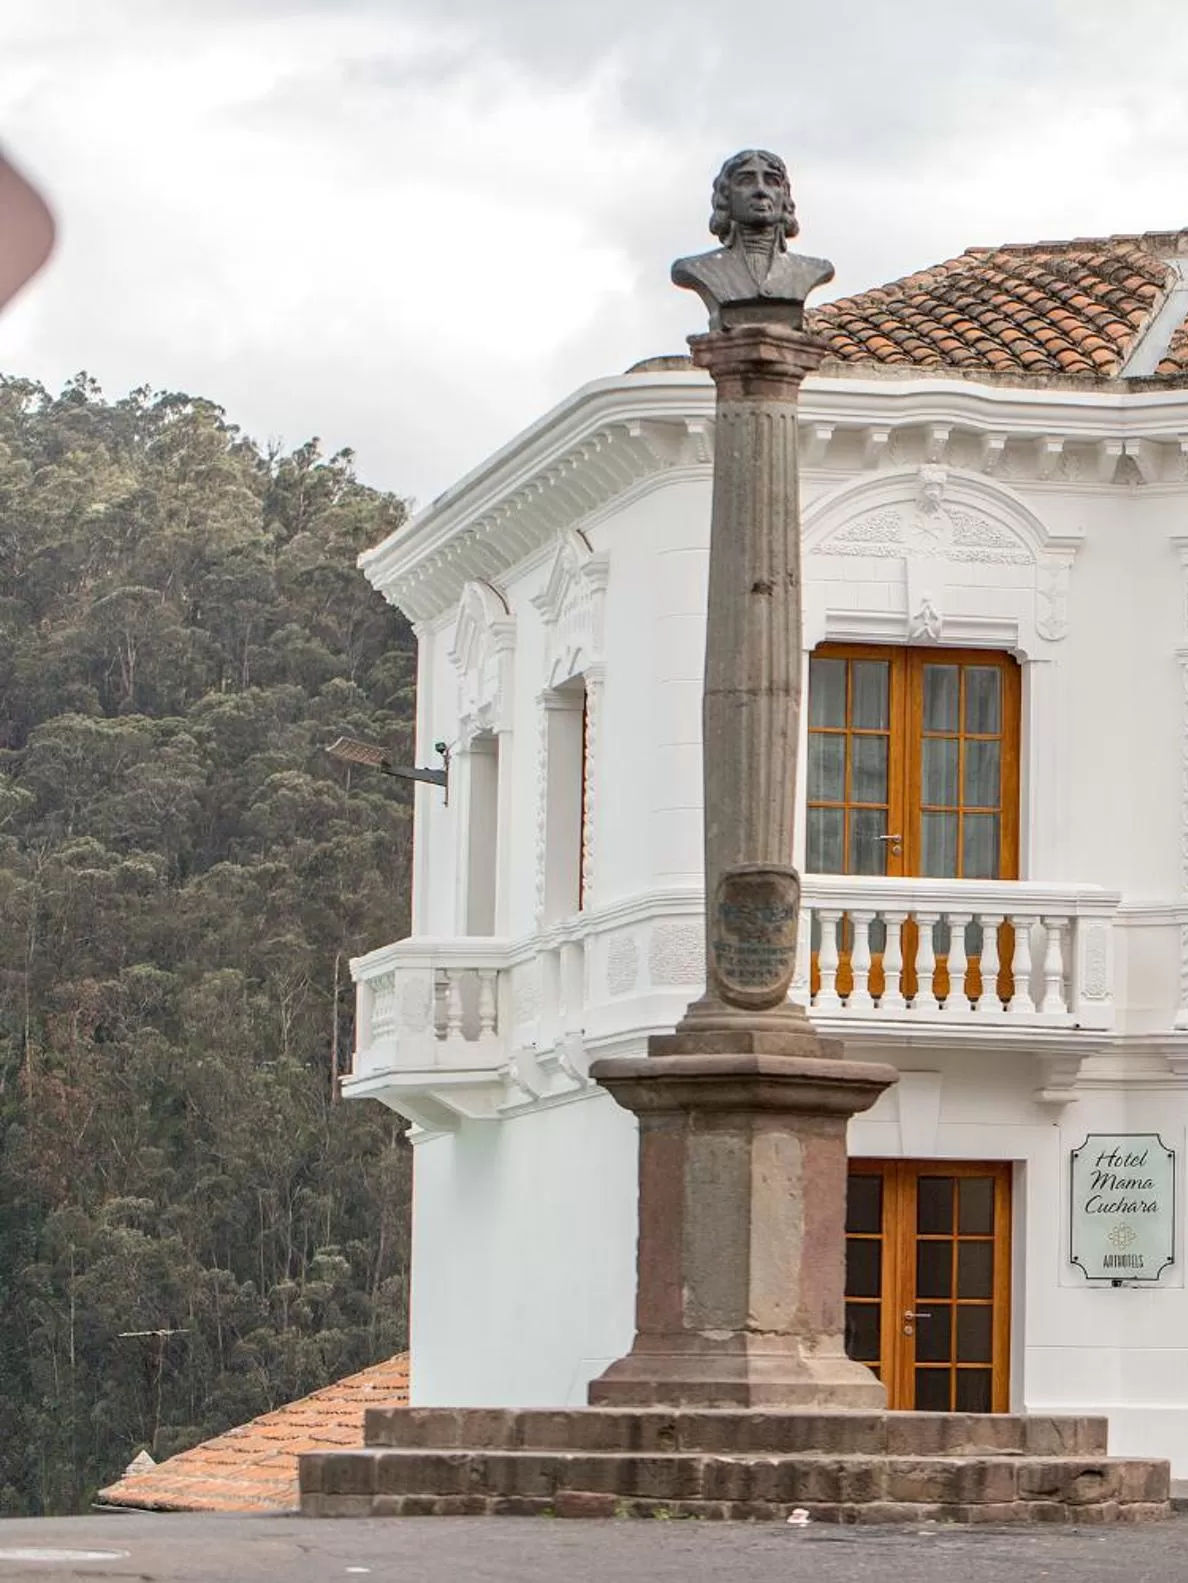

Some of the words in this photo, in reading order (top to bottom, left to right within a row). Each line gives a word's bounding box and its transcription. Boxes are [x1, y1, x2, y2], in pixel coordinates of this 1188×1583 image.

[1095, 1146, 1149, 1167] Hotel
[1090, 1169, 1155, 1191] Mama
[1085, 1194, 1159, 1214] Cuchara
